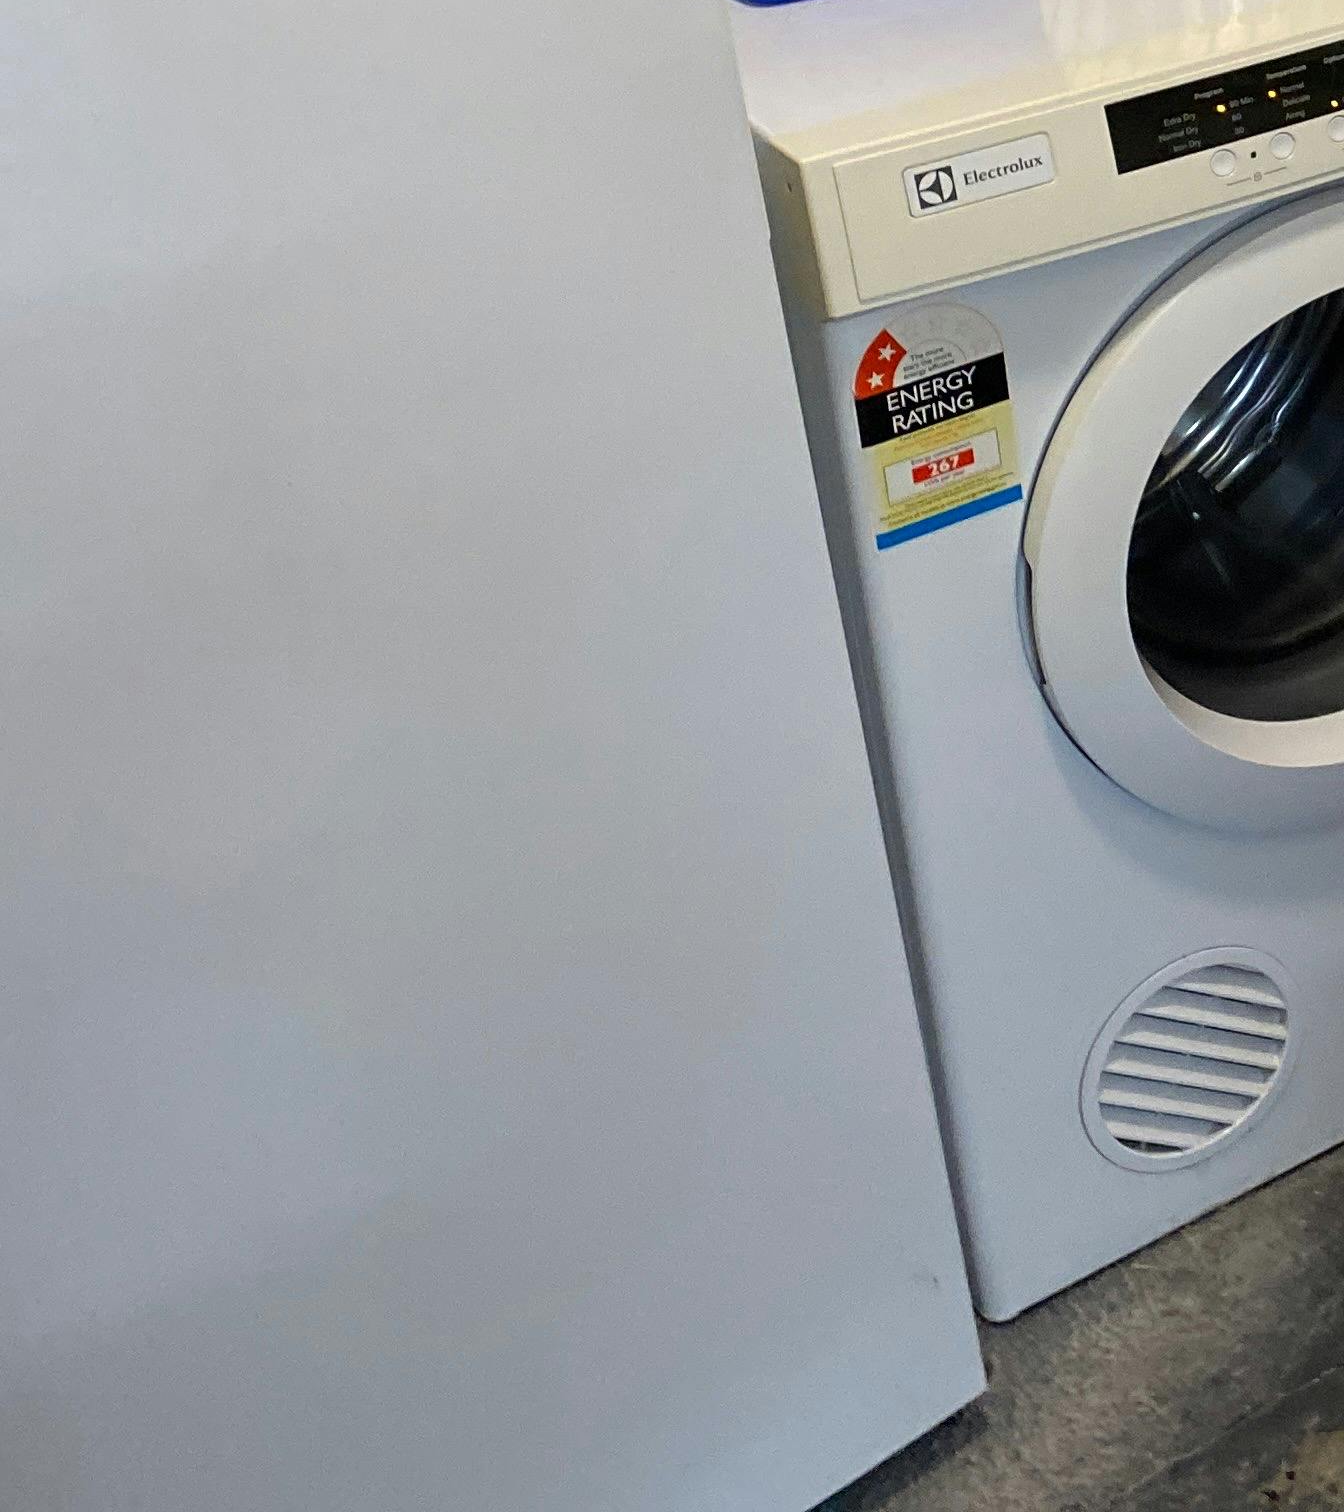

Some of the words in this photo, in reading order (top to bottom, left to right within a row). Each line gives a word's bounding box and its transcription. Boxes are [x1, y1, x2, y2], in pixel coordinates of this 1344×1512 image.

[964, 156, 1043, 186] Electrolux
[887, 365, 976, 412] ENERGY
[892, 391, 975, 433] RATING
